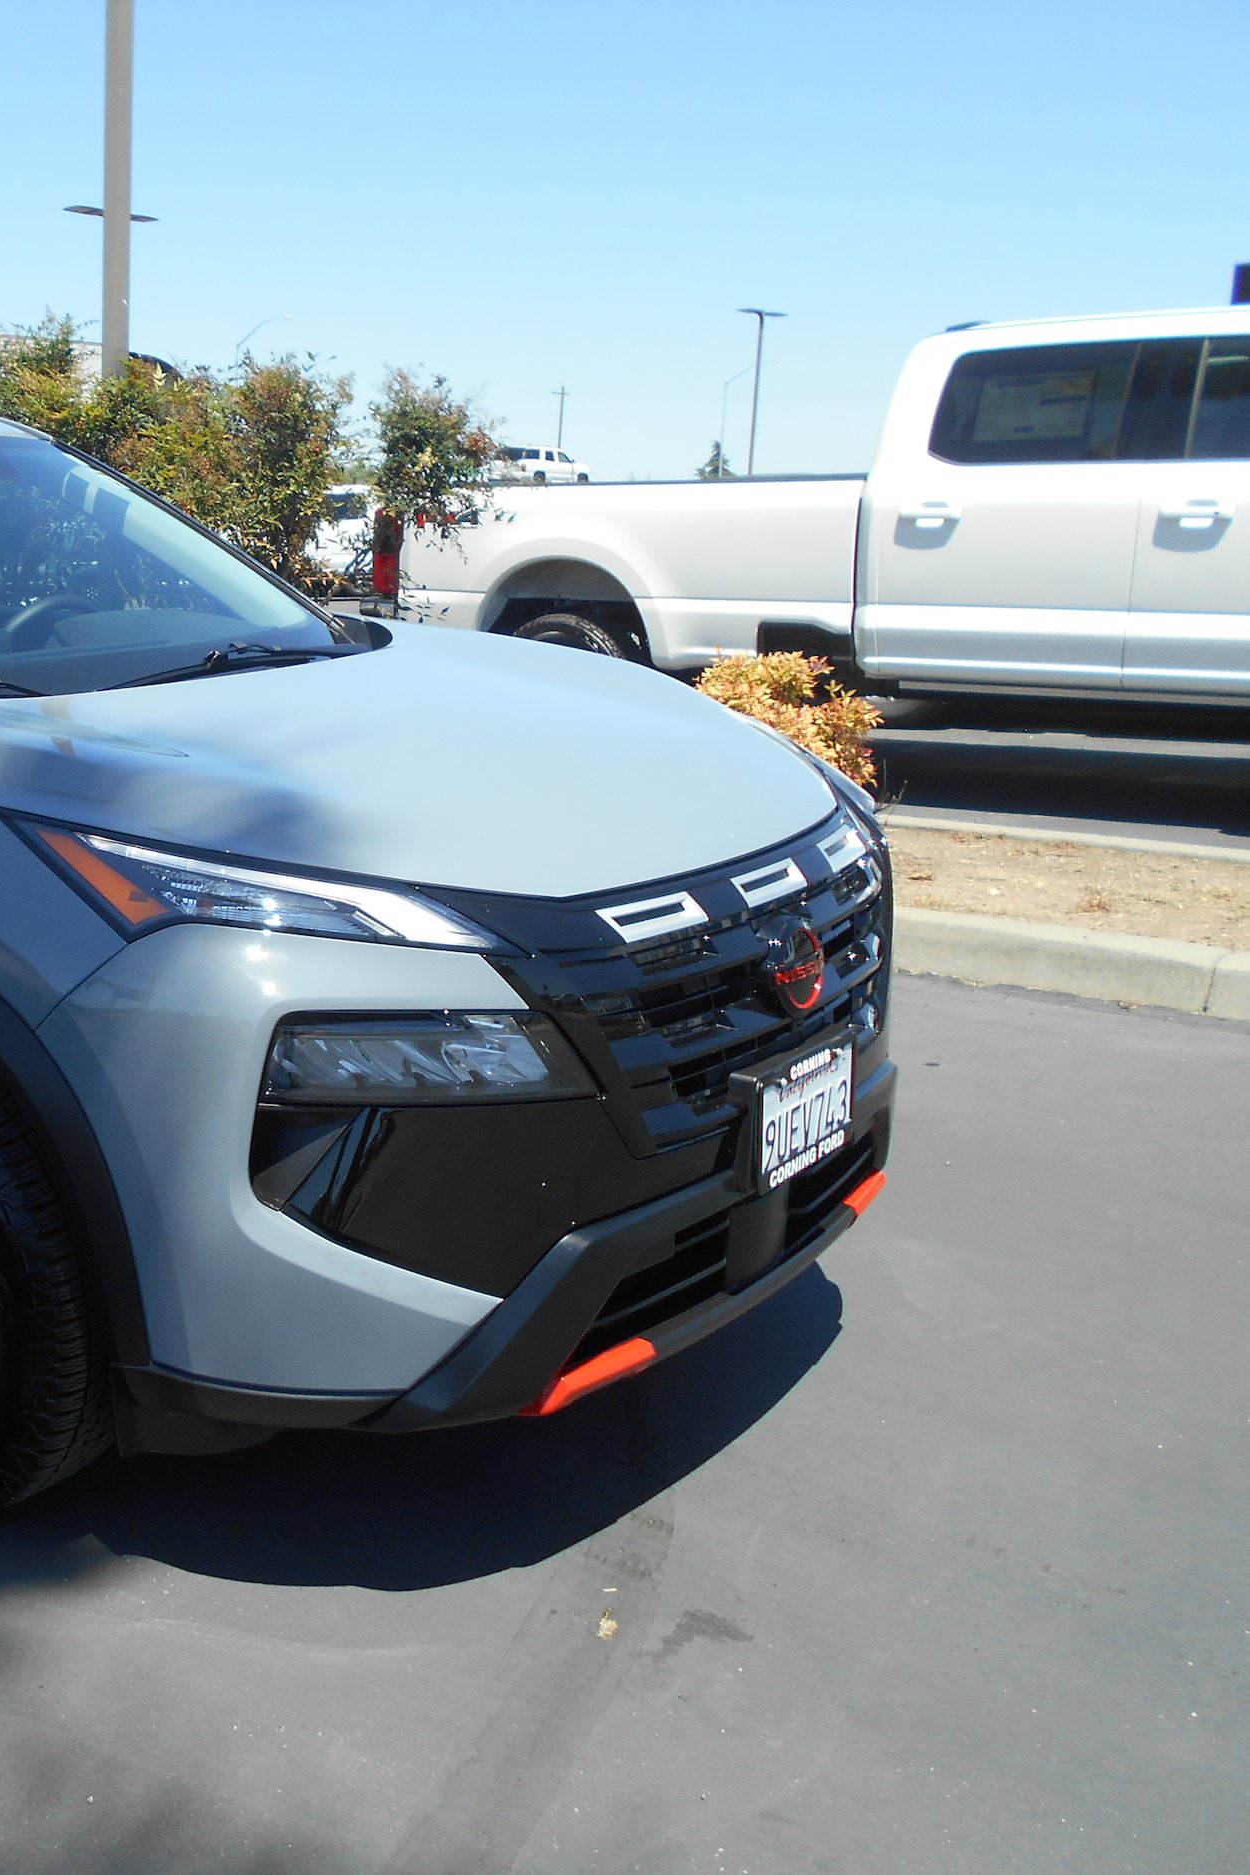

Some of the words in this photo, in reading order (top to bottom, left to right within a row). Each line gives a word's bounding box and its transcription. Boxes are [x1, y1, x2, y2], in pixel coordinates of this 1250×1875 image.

[774, 961, 823, 985] NISS
[790, 1048, 831, 1080] CORNING
[765, 1078, 848, 1172] 9UEV743
[769, 1146, 817, 1188] CORNING
[818, 1129, 845, 1159] FORD
